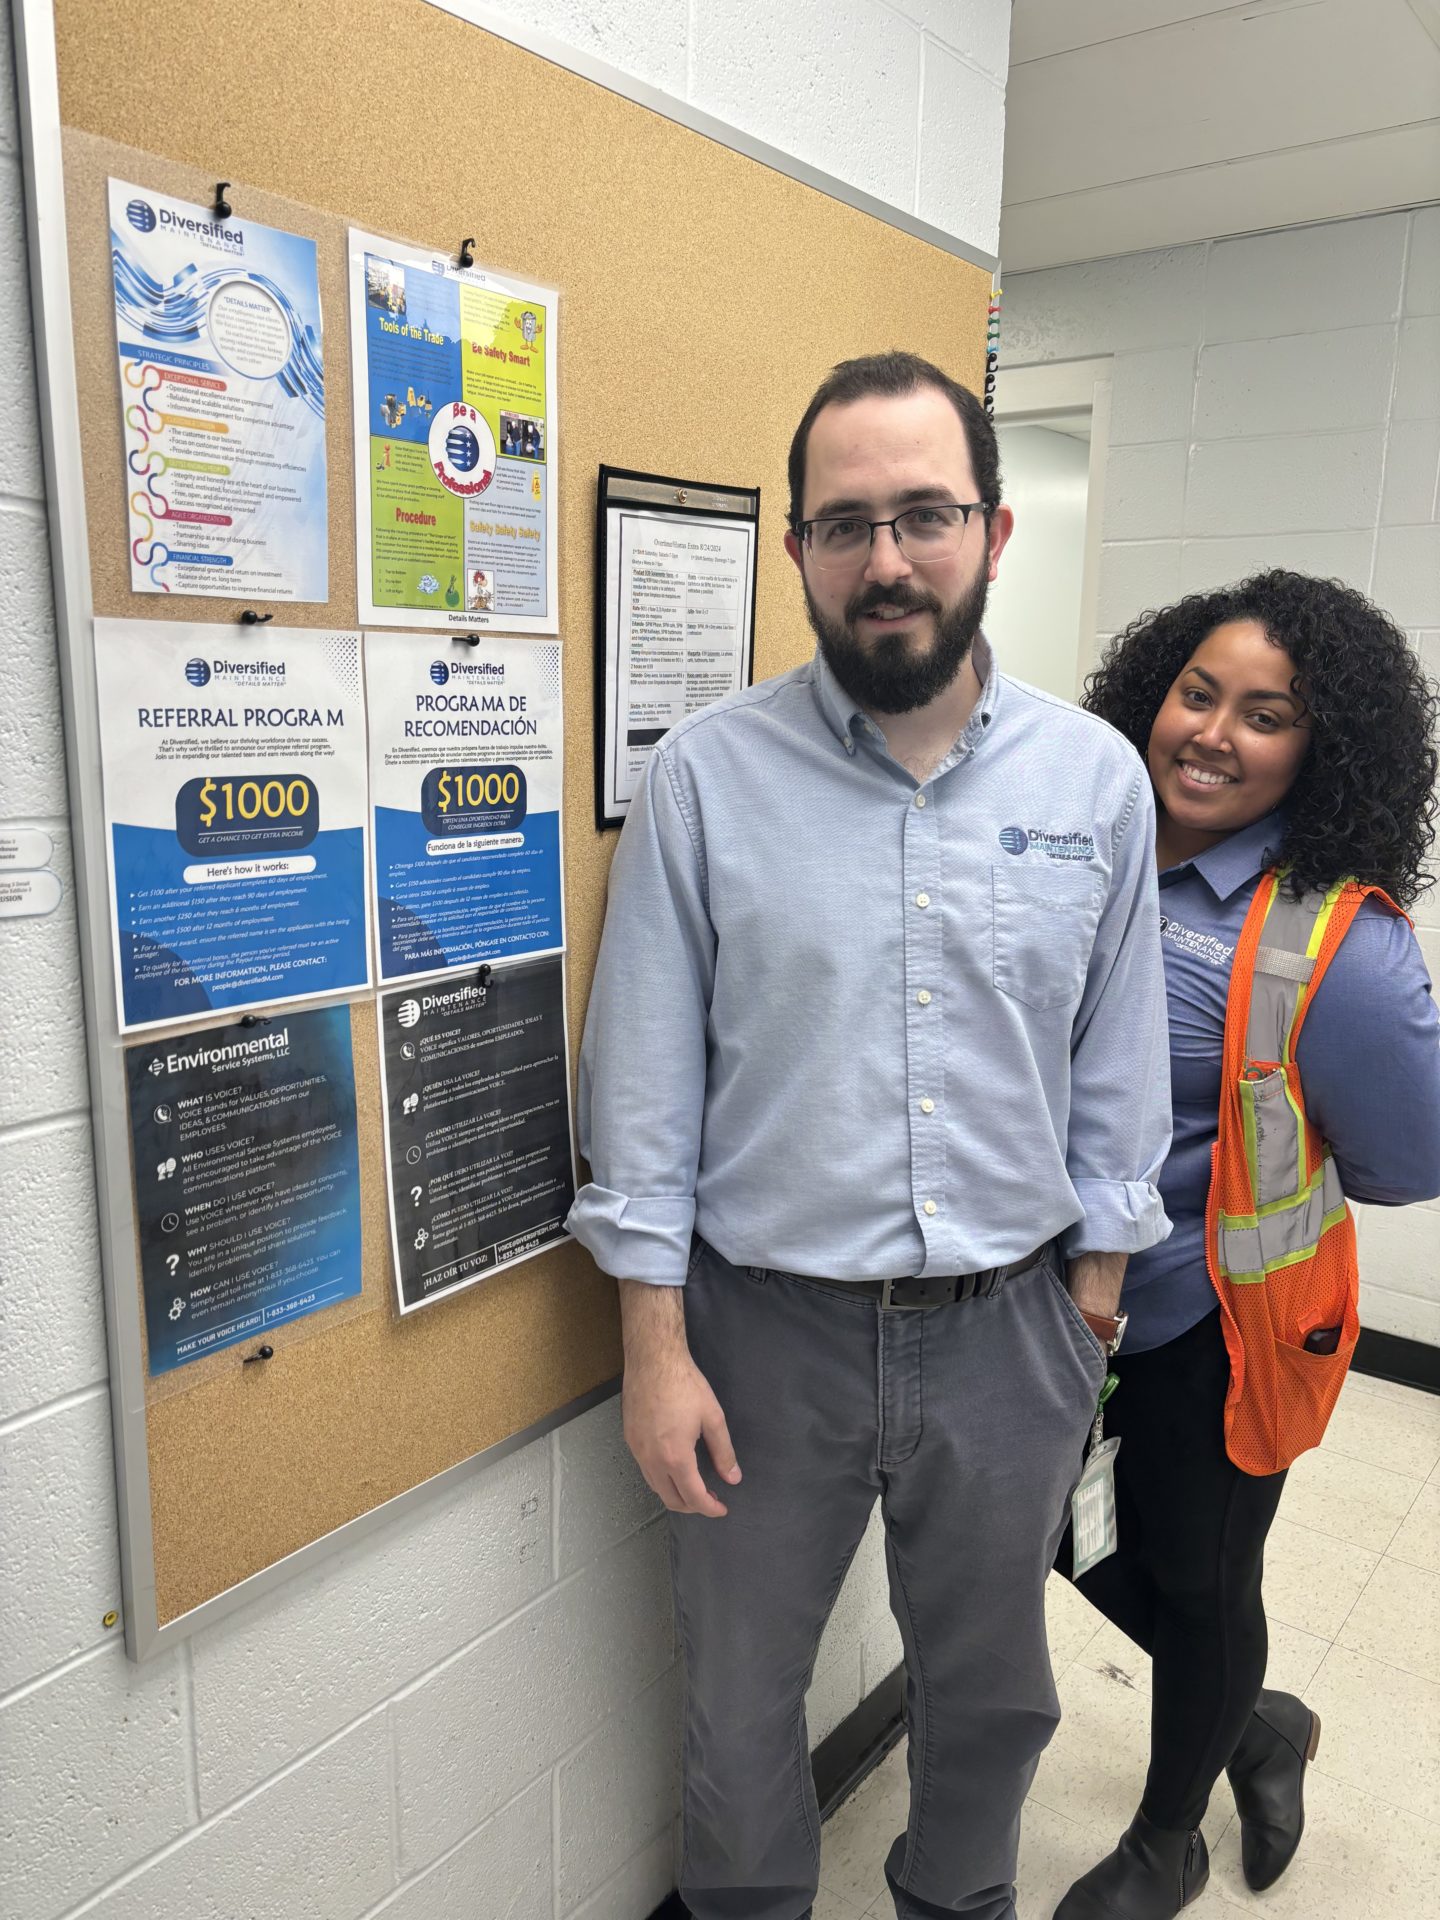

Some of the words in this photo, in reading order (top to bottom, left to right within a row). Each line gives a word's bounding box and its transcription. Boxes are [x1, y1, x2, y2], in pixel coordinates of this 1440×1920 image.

[160, 209, 243, 245] Diversified
[160, 225, 244, 251] MAINTENANCE
[224, 296, 248, 308] "DETAILS
[248, 302, 273, 312] MATTER"
[379, 319, 399, 334] Tools
[400, 325, 409, 337] of
[410, 327, 422, 340] the
[423, 330, 444, 346] Trade
[138, 349, 173, 363] STRATEGIC
[174, 357, 210, 370] PRINCIPLES
[472, 342, 482, 354] Be
[484, 345, 507, 364] Safety
[508, 352, 530, 367] Smart
[164, 372, 199, 385] EXCEPTIONAL
[199, 379, 221, 389] SERVICE
[452, 402, 467, 418] Be
[470, 409, 476, 421] a
[434, 462, 492, 494] Professional
[176, 520, 202, 530] Teamwork
[191, 512, 226, 522] ORGANIZATION
[396, 508, 436, 526] Procedure
[176, 538, 195, 549] Sharing
[196, 541, 210, 549] ideas
[469, 521, 493, 538] Safety
[494, 524, 517, 541] Safety
[518, 527, 541, 544] Safety
[173, 552, 199, 561] FINANCIAL
[200, 555, 227, 564] STRENGTH
[448, 614, 468, 622] Details
[468, 615, 489, 623] Matters
[213, 660, 286, 674] Diversified
[451, 662, 504, 675] Diversified
[416, 695, 505, 711] PROGRAMA
[509, 695, 527, 711] DE
[138, 709, 238, 727] REFERRAL
[245, 708, 344, 727] PROGRAM
[405, 715, 537, 737] RECOMENDACIÓN
[438, 770, 519, 812] $1000
[200, 778, 309, 827] $1000
[216, 834, 239, 842] CHANCE
[282, 830, 304, 838] INCOME
[428, 842, 455, 851] Funciona
[457, 840, 465, 848] de
[466, 839, 472, 848] la
[473, 837, 499, 848] siguiente
[500, 834, 523, 844] manera:
[1028, 829, 1094, 846] Diversified
[1029, 843, 1095, 855] MAINTENANCE
[207, 866, 232, 877] Here's
[234, 865, 252, 874] how
[255, 863, 261, 872] it
[262, 860, 289, 872] works:
[404, 951, 420, 960] PARA
[420, 948, 433, 957] MÁS
[434, 942, 475, 955] INFORMACIÓN,
[475, 938, 500, 948] PÓNGASE
[500, 936, 507, 944] EN
[508, 931, 537, 942] CONTACTO
[537, 929, 550, 938] CON:
[1163, 931, 1228, 963] MAINTENANCE
[1168, 922, 1234, 956] Diversified
[174, 977, 190, 986] FOR
[191, 973, 214, 983] MORE
[214, 966, 268, 980] INFORMATION,
[269, 962, 291, 971] PLEASE
[292, 956, 327, 968] CONTACT:
[422, 984, 487, 1010] Diversified
[424, 996, 487, 1016] MAINTENANCE
[441, 1007, 463, 1016] "DETAILS
[464, 1002, 487, 1011] MATTER"
[166, 1028, 289, 1073] Environmental
[211, 1061, 240, 1073] Service
[242, 1054, 276, 1067] Systems,
[277, 1047, 290, 1058] LLC
[177, 1096, 204, 1109] WHAT
[205, 1094, 212, 1102] IS
[214, 1086, 242, 1100] VOICE?
[178, 1108, 202, 1120] VOICE
[203, 1102, 226, 1114] stands
[239, 1091, 269, 1104] VALUES,
[180, 1118, 204, 1130] IDEAS,
[212, 1097, 280, 1122] COMMUNICATIONS
[280, 1094, 297, 1103] from
[298, 1091, 310, 1099] our
[180, 1123, 227, 1141] EMPLOYEES.
[181, 1150, 204, 1163] WHO
[205, 1144, 225, 1156] USES
[227, 1136, 255, 1150] VOICE?
[184, 1201, 211, 1215] WHEN
[213, 1197, 226, 1207] DO
[232, 1190, 246, 1201] USE
[247, 1182, 275, 1196] VOICE?
[187, 1245, 208, 1258] WHY
[210, 1234, 242, 1250] SHOULD
[248, 1227, 263, 1238] USE
[264, 1218, 291, 1233] VOICE?
[190, 1286, 211, 1298] HOW
[212, 1279, 230, 1291] CAN
[235, 1271, 250, 1283] USE
[251, 1261, 278, 1277] VOICE?
[444, 1266, 458, 1279] OÍR
[458, 1261, 470, 1273] TU
[177, 1341, 198, 1354] MAKE
[199, 1334, 216, 1346] YOUR
[216, 1326, 236, 1339] VOICE
[236, 1316, 261, 1331] HEARD!
